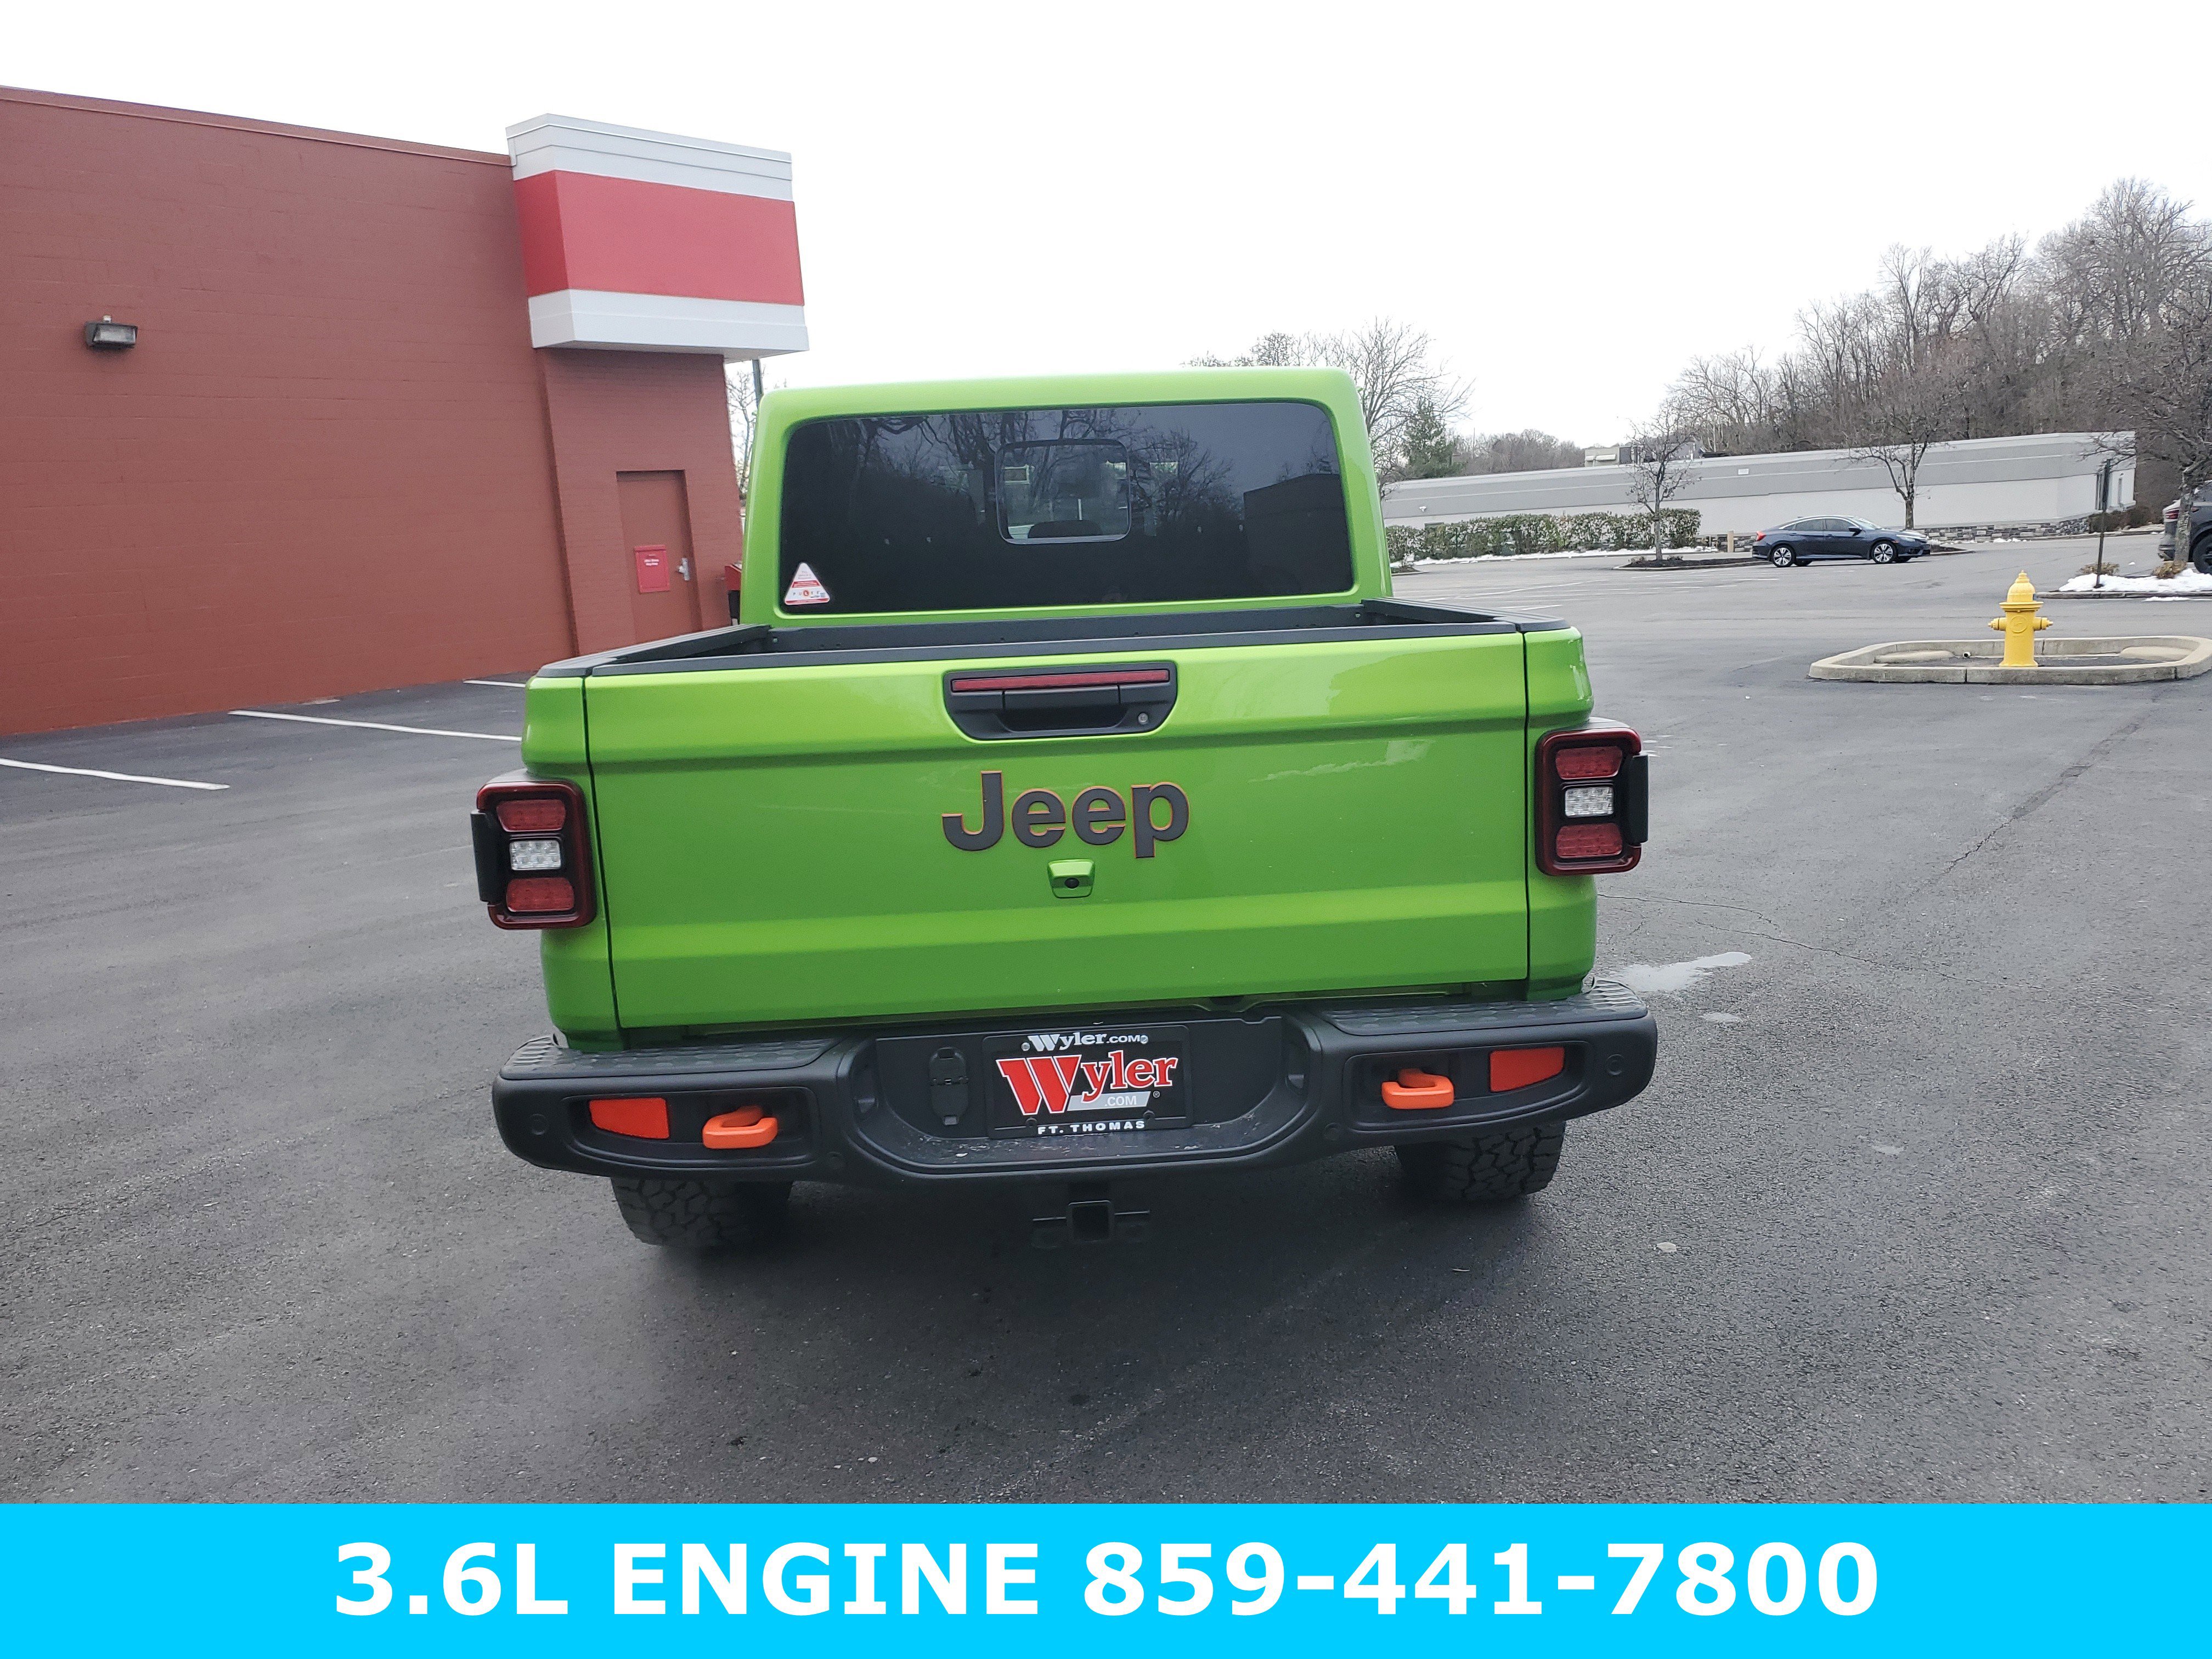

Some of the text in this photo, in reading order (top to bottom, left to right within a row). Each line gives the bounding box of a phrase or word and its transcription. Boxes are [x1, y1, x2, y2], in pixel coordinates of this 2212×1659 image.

[941, 770, 1189, 859] Jeep
[995, 1049, 1179, 1116] Wyler
[1037, 1120, 1146, 1135] FT. THOMAS
